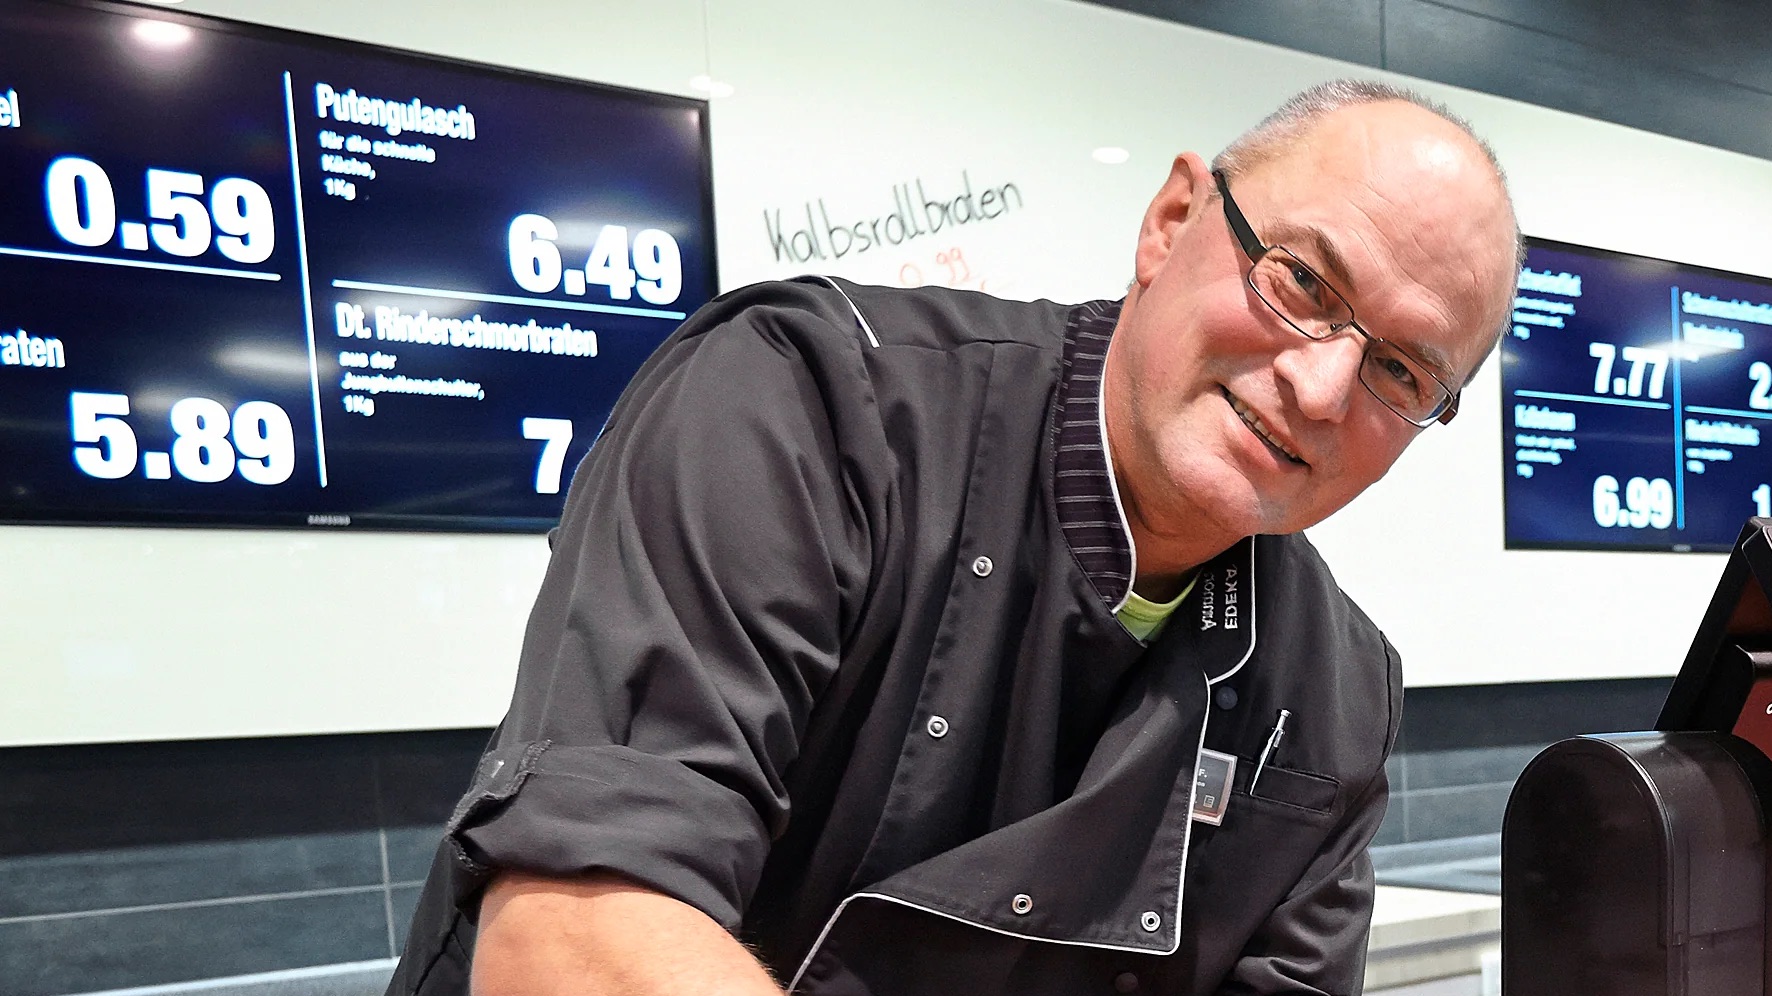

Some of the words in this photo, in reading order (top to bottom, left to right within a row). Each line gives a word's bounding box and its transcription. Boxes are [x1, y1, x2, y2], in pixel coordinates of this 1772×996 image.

[316, 82, 476, 140] Putengulasch
[319, 130, 344, 150] für
[345, 135, 371, 154] die
[372, 140, 436, 163] schnelle
[46, 156, 276, 264] 0.59
[508, 213, 683, 305] 6.49
[0, 328, 66, 368] aten
[335, 302, 372, 339] Dt.
[375, 305, 598, 358] Rinderschmorbraten
[370, 351, 397, 370] der
[1589, 342, 1669, 399] 7.77
[70, 392, 296, 486] 5.89
[1592, 474, 1674, 529] 6.99
